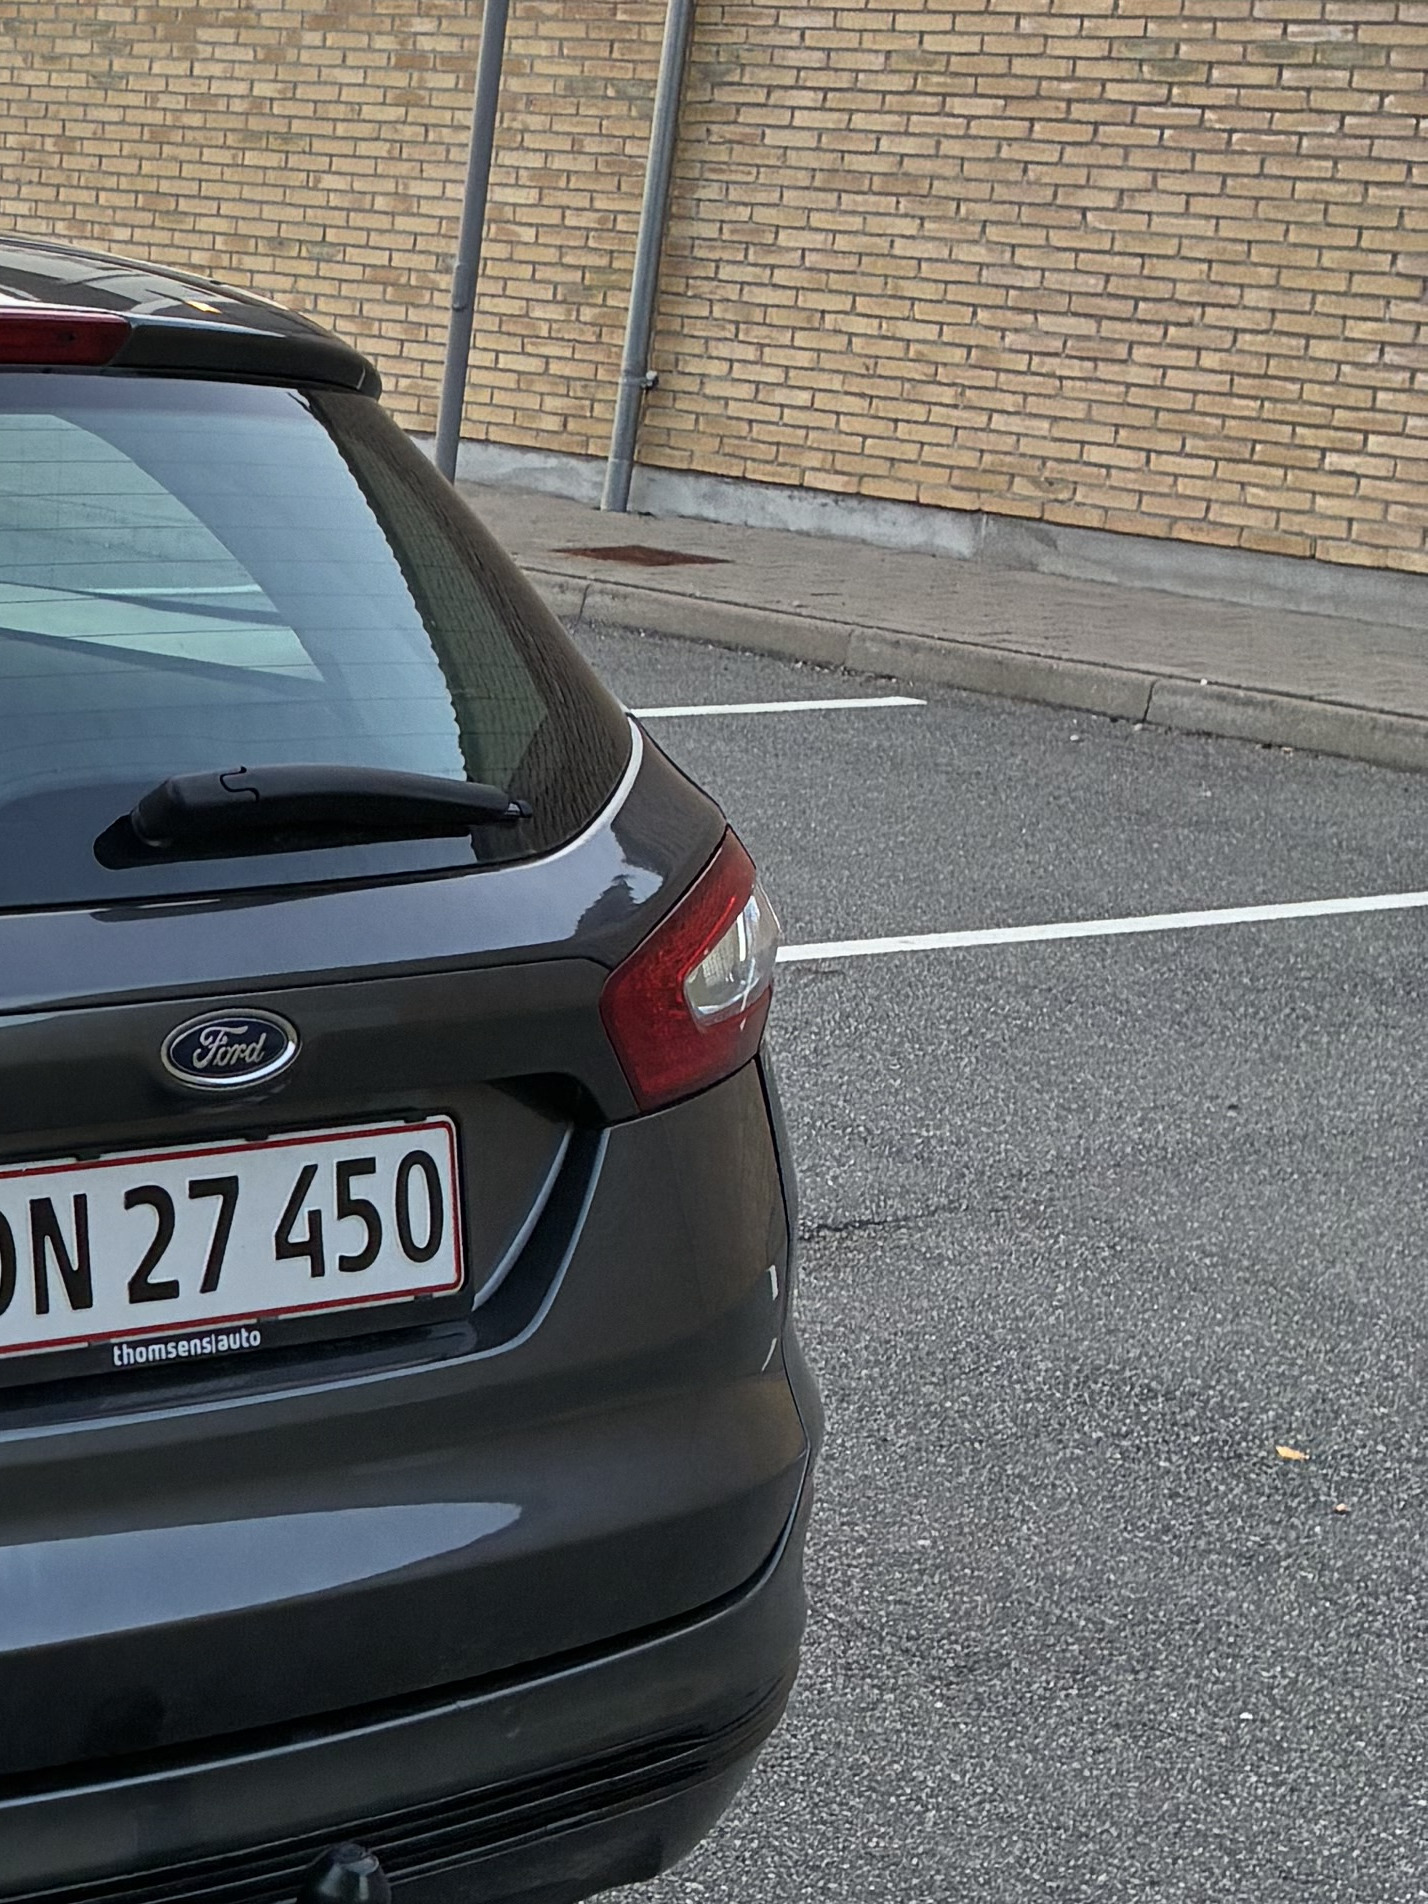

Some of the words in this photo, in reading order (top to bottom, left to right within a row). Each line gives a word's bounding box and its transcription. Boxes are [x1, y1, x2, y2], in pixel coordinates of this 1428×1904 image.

[193, 1026, 266, 1068] Ford
[124, 1175, 239, 1303] 27
[275, 1150, 443, 1277] 450
